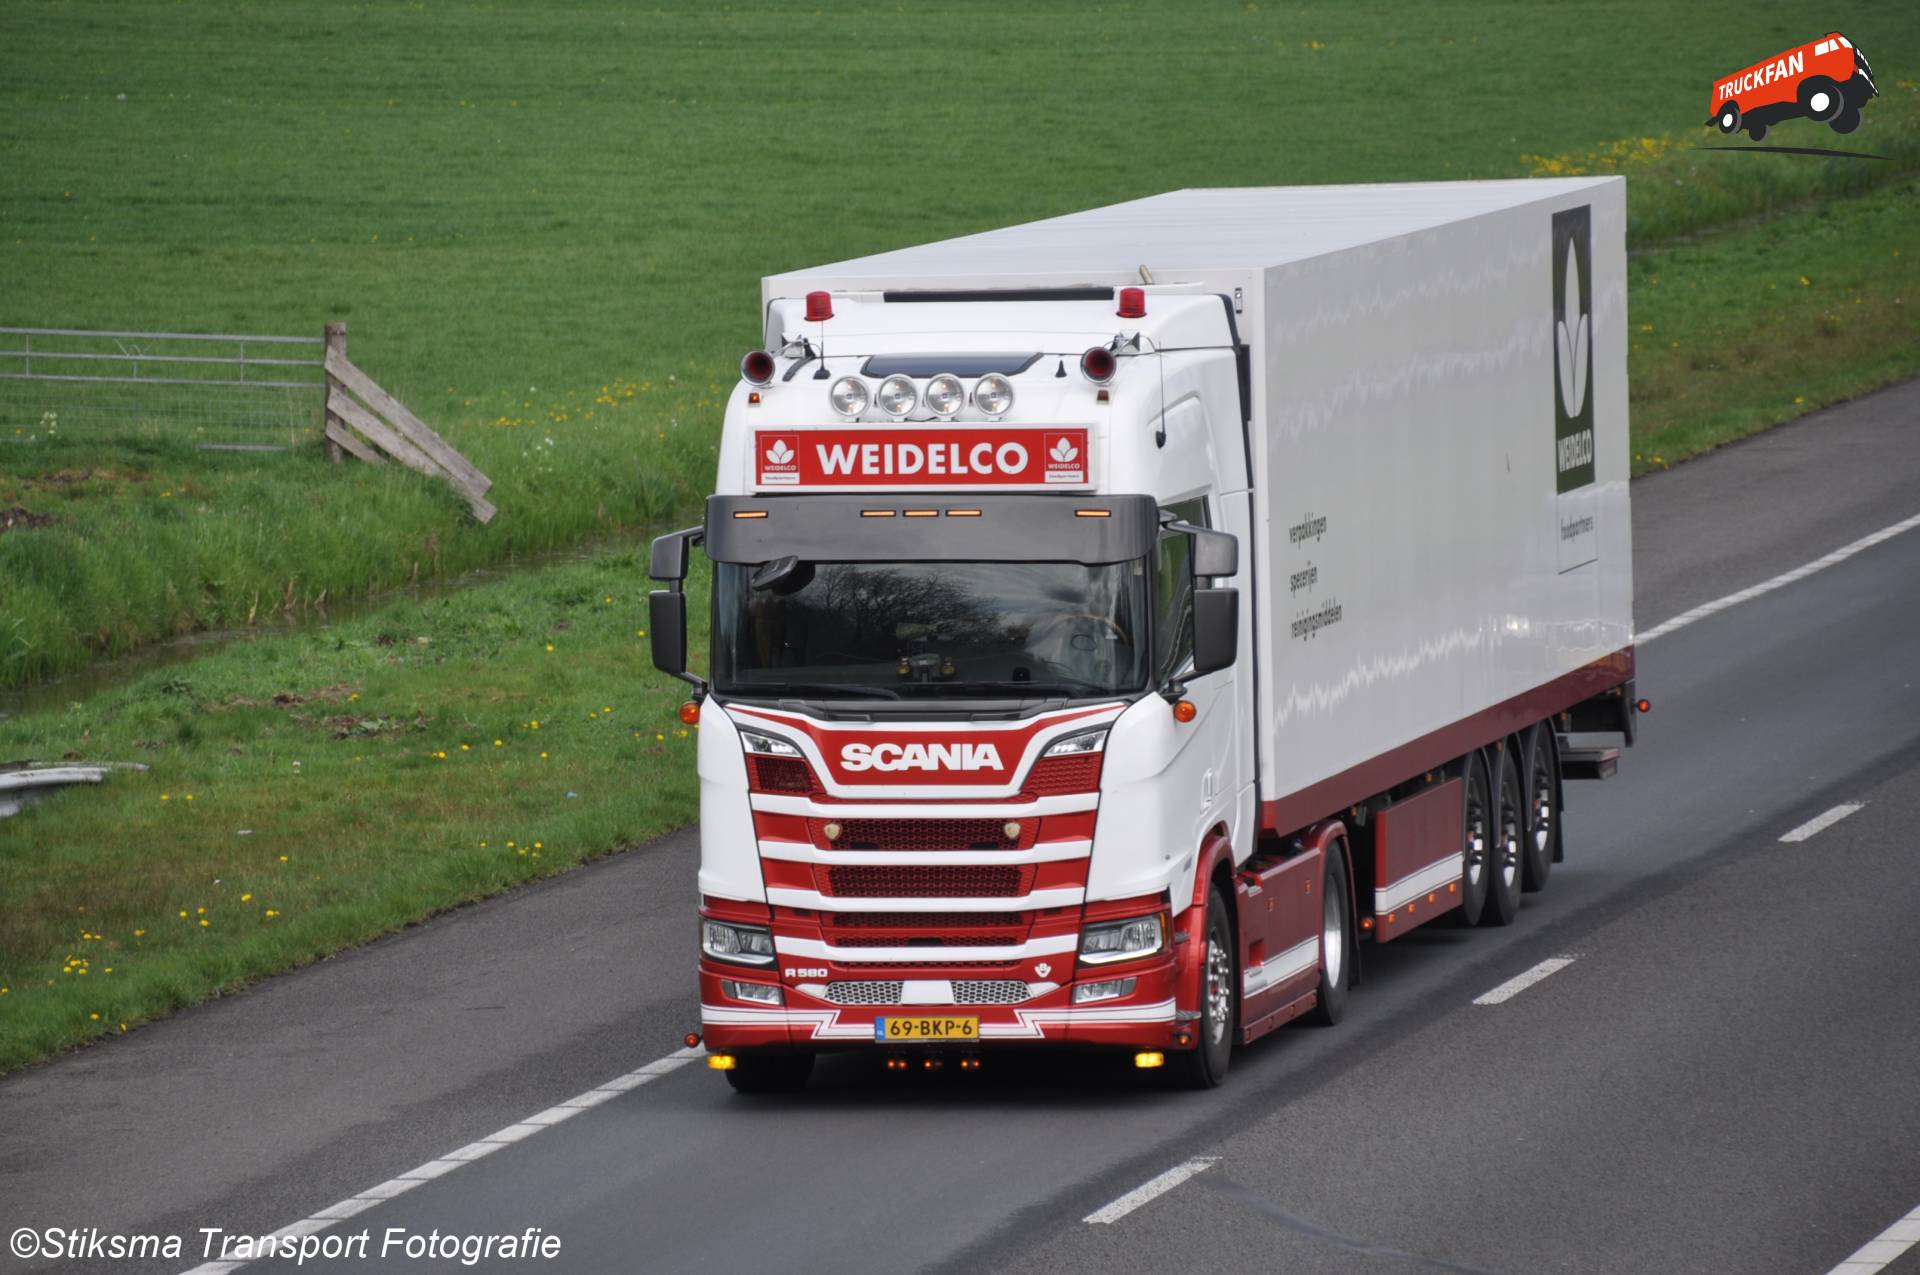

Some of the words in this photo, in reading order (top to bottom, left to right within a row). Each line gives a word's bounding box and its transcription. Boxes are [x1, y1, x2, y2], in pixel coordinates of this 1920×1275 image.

[816, 442, 1029, 475] WEIDELCO
[1558, 429, 1593, 472] WEIDELCO
[1289, 512, 1327, 549] verpakkingen
[840, 743, 1004, 771] SCANIA
[784, 968, 796, 977] R
[797, 968, 828, 977] 580
[890, 1019, 972, 1036] 69-BKP-6
